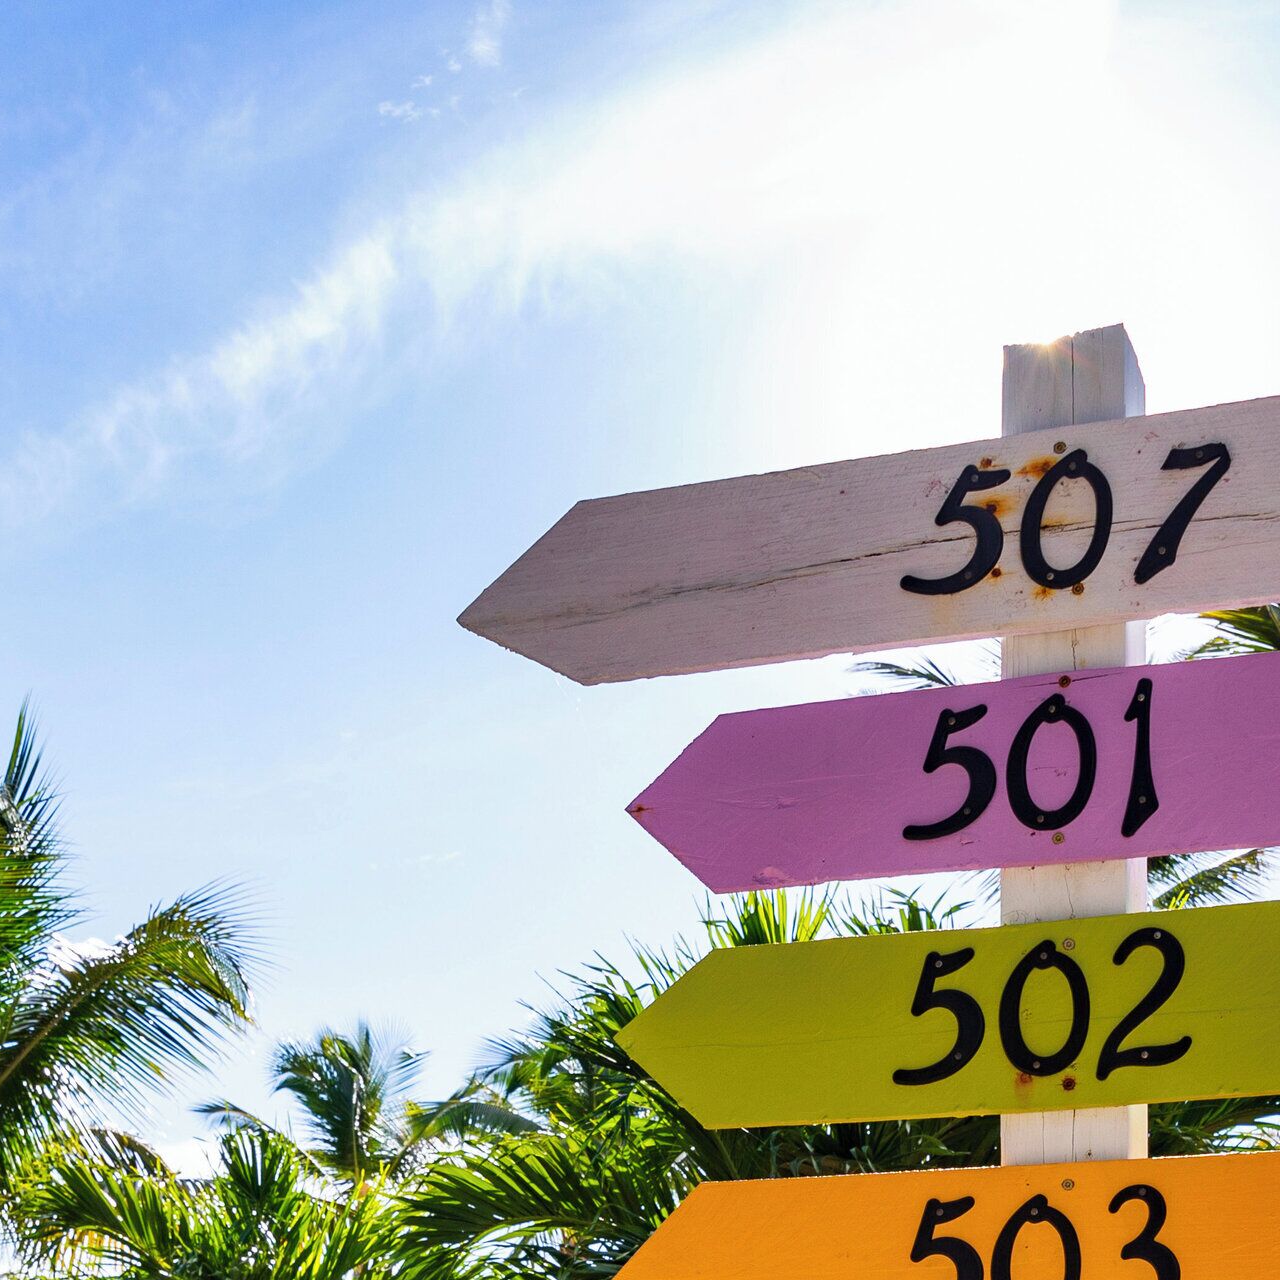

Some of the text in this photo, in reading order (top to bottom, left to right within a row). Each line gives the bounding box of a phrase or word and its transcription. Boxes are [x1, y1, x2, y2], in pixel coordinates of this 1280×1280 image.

[899, 441, 1232, 596] 507
[901, 677, 1160, 842] 501
[891, 926, 1193, 1086] 502
